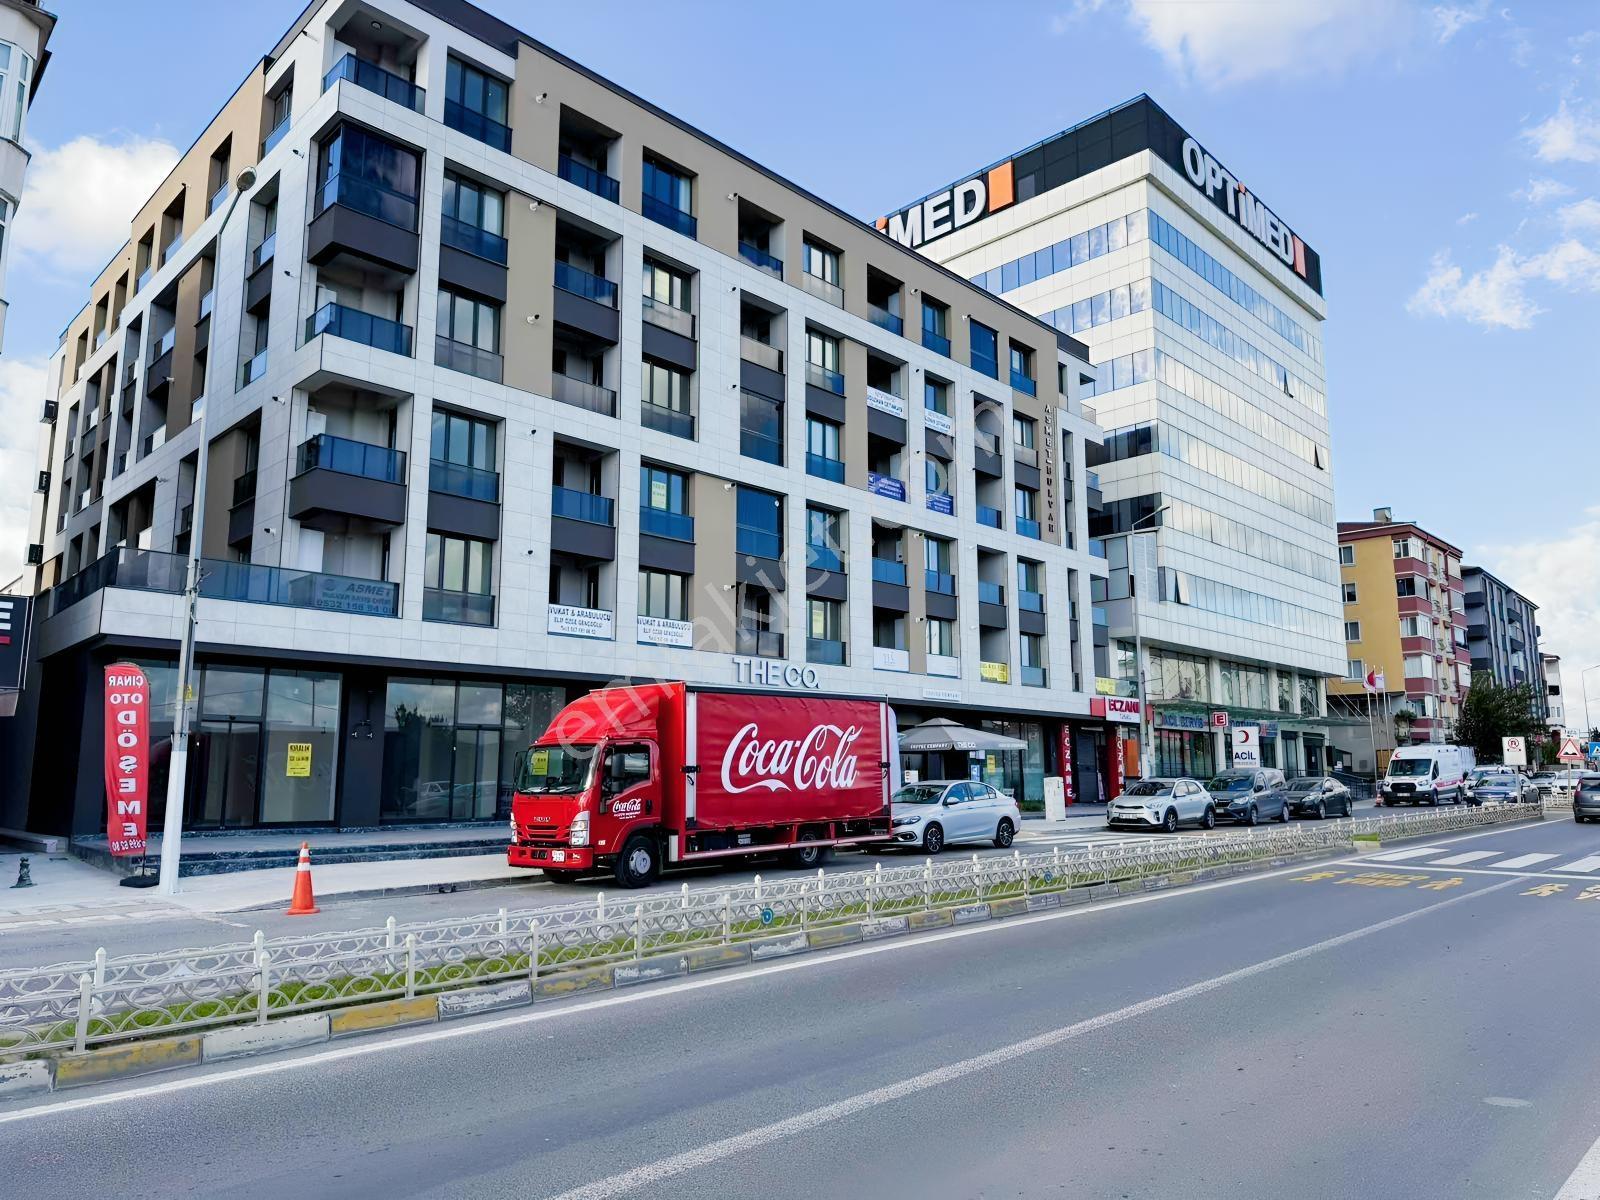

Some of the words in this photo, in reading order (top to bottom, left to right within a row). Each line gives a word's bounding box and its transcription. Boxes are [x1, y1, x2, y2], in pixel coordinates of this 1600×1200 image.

[732, 656, 780, 686] THE
[1108, 698, 1140, 713] ECZAN
[1216, 715, 1225, 725] E
[720, 722, 864, 794] Coca-Cola
[1064, 724, 1073, 797] ECZANE
[1234, 750, 1256, 760] ACİL
